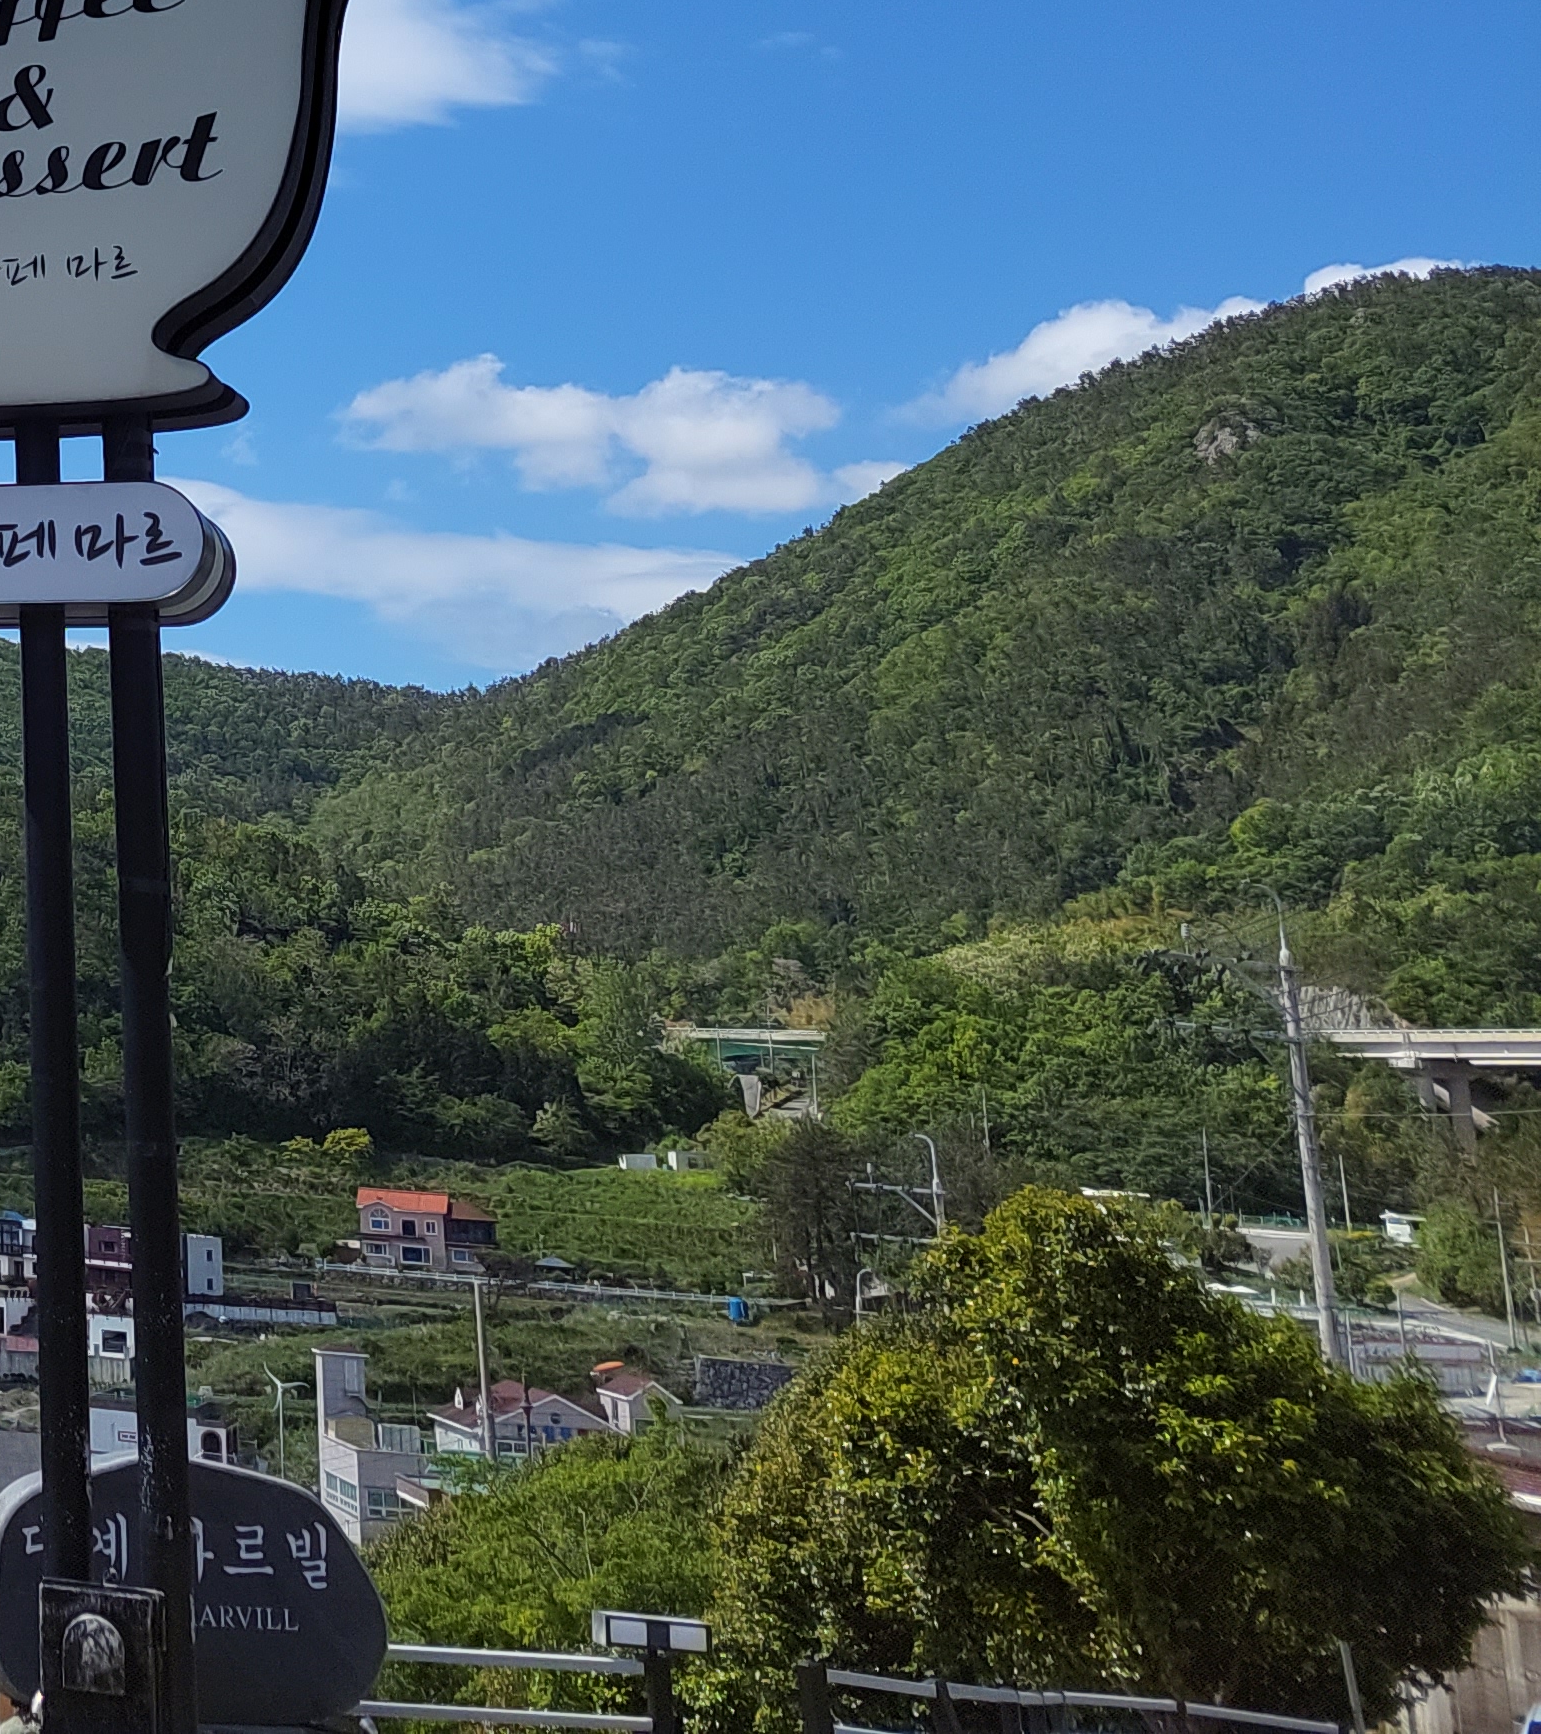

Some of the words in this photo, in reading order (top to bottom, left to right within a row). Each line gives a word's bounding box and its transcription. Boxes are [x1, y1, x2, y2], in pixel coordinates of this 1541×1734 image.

[66, 245, 139, 282] 마르
[74, 511, 183, 569] 마르
[196, 1604, 300, 1632] ARVILL
